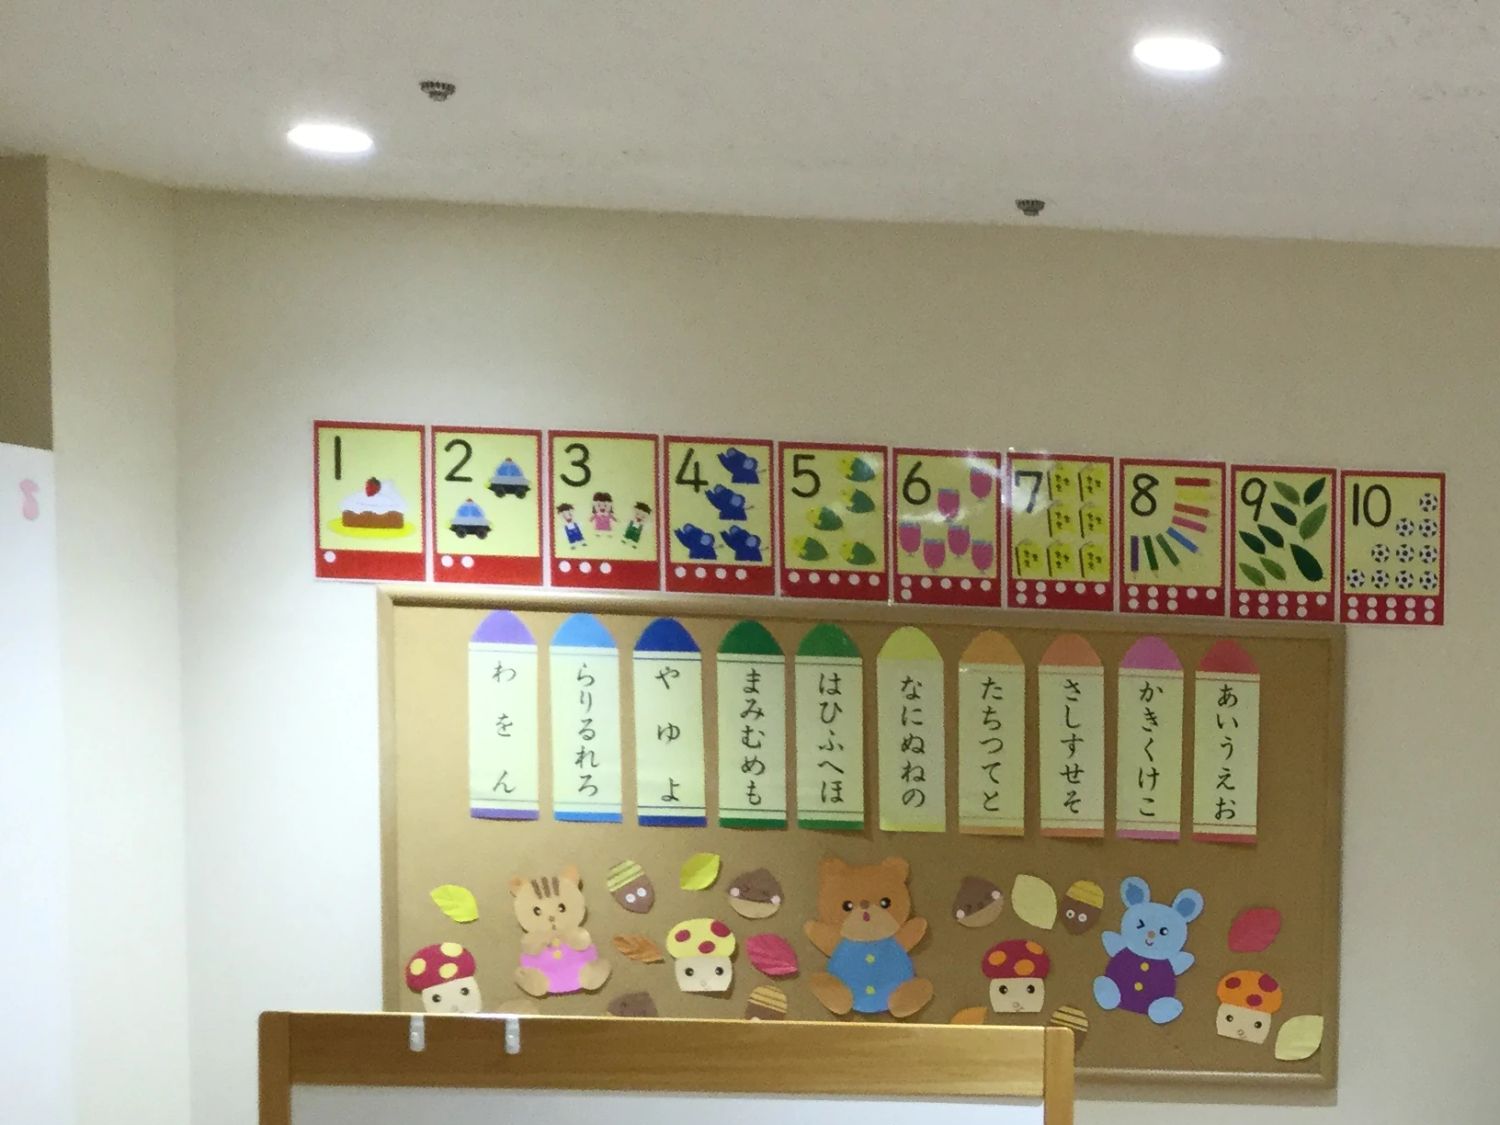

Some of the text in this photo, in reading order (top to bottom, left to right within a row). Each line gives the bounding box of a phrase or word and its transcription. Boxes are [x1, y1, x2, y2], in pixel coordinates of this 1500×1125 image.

[335, 436, 341, 480] 1
[445, 439, 473, 483] 2
[560, 443, 591, 487] 3
[676, 448, 708, 492] 4
[792, 454, 821, 498] 5
[903, 461, 931, 505] 6
[1014, 470, 1043, 513] 7
[1131, 474, 1157, 516] 8
[1241, 477, 1267, 521] 9
[1352, 483, 1391, 527] 10
[575, 664, 600, 797] らりるれろ
[740, 668, 765, 806] まみむめも
[818, 673, 844, 804] はひふへほ
[901, 675, 926, 808] なにぬねの
[980, 677, 1003, 813] たちつてと
[1059, 678, 1084, 814] さしすせそ
[1138, 680, 1163, 817] かきくけこ
[1214, 684, 1238, 820] あいうえお
